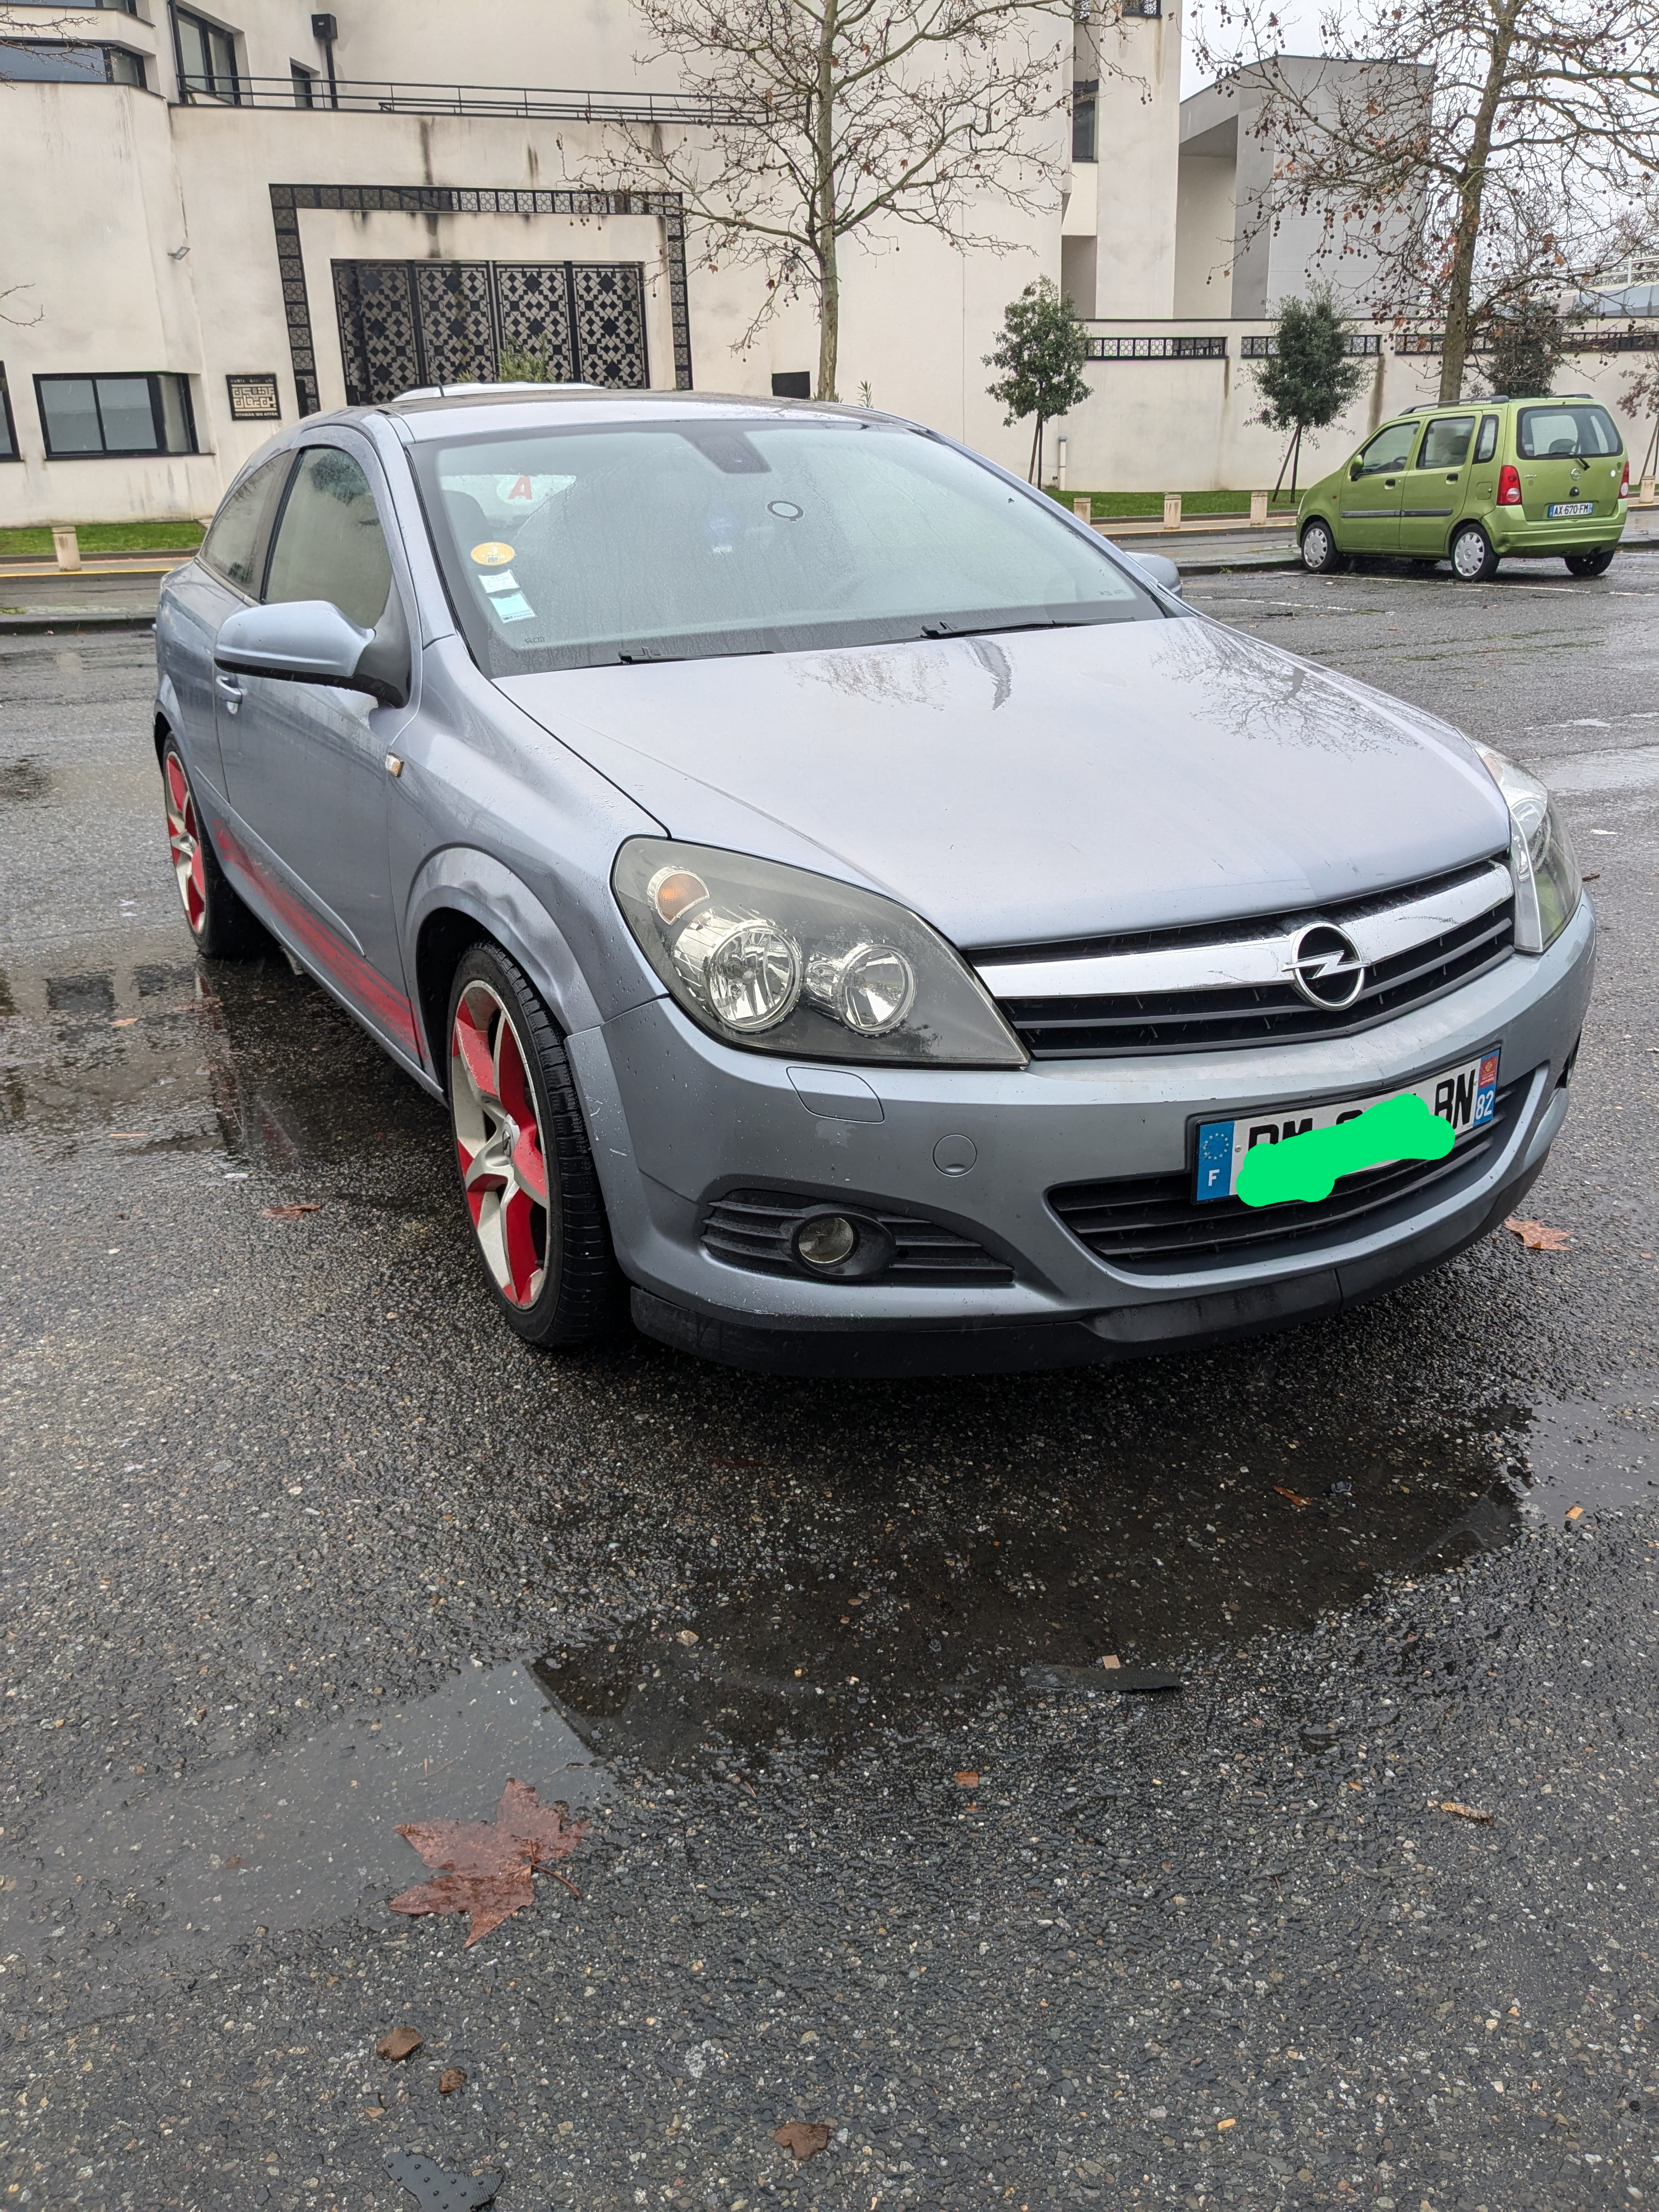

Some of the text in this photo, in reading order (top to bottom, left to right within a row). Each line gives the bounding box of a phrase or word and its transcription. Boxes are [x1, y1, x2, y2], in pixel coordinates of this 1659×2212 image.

[508, 475, 533, 500] A
[1475, 1090, 1494, 1120] 82
[1208, 1169, 1220, 1187] F
